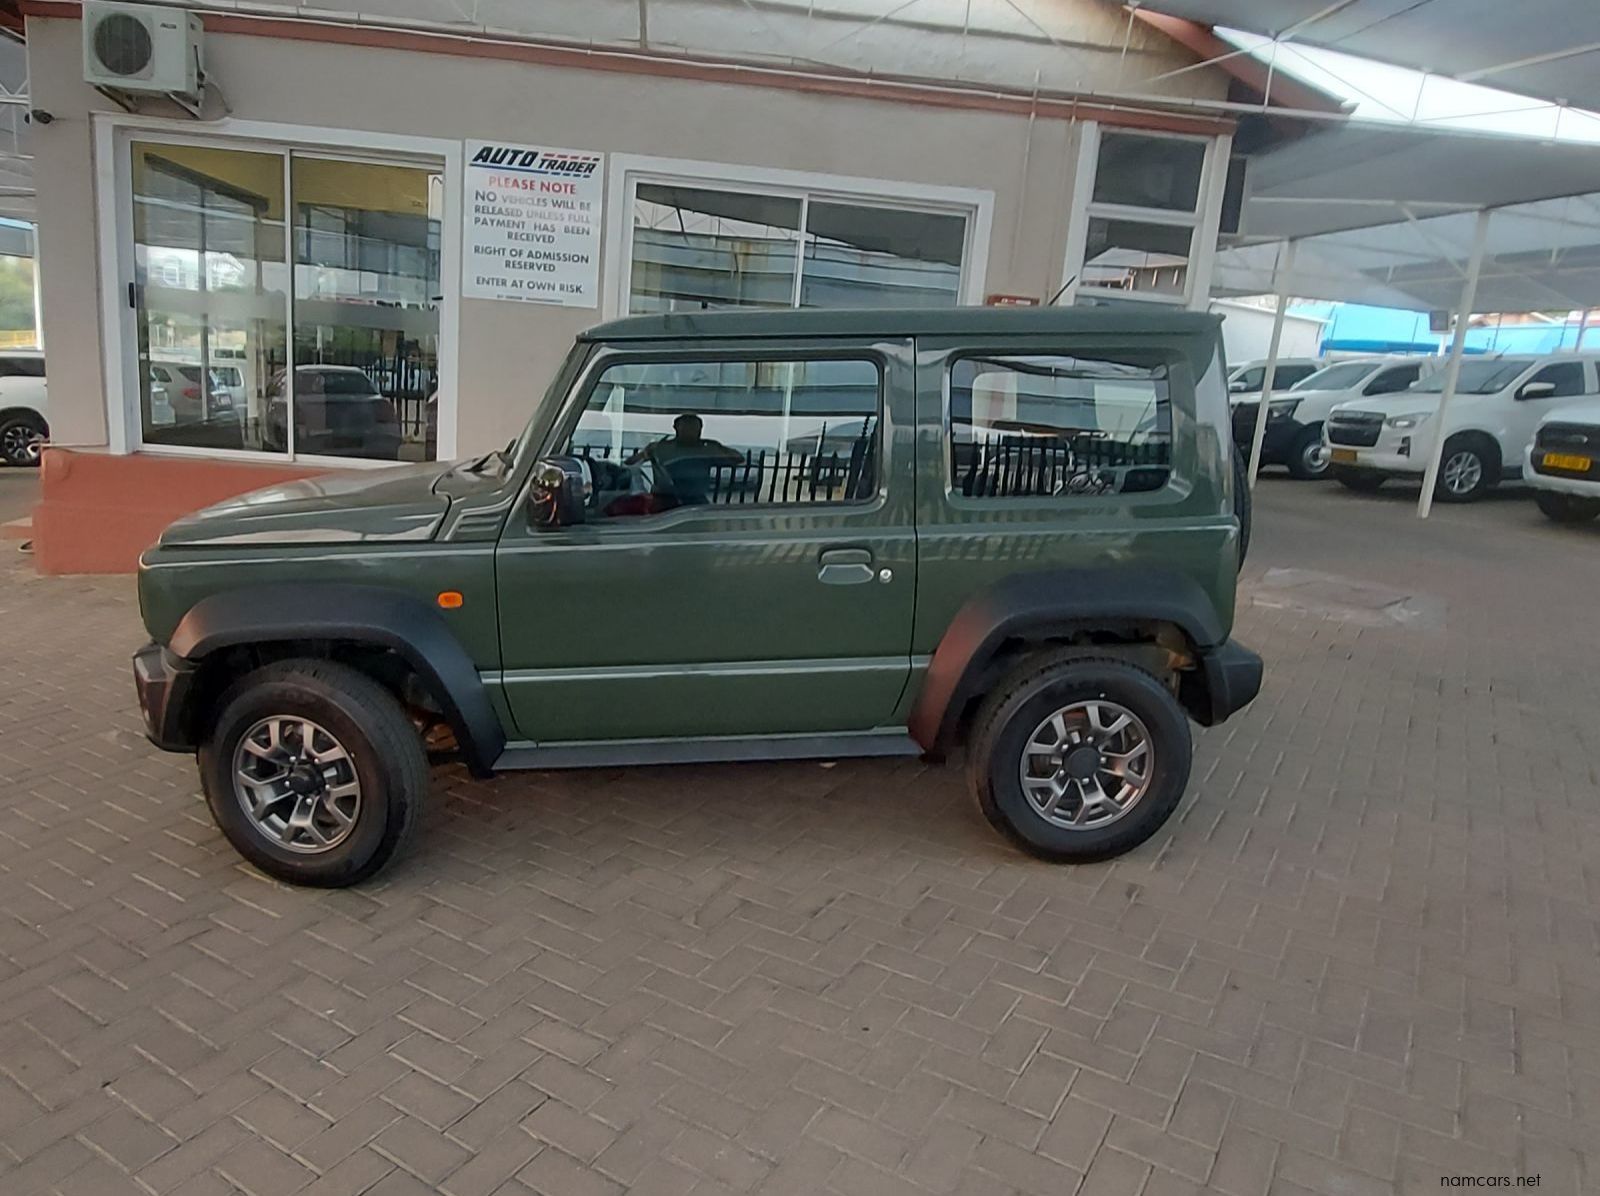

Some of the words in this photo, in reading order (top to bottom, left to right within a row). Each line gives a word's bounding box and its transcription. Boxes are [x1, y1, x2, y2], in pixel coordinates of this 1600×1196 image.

[472, 146, 539, 168] AUTO
[538, 158, 597, 174] TRADER
[488, 175, 536, 191] PLEASE
[540, 181, 577, 195] NOTE
[475, 190, 497, 202] NO
[501, 194, 548, 208] VEHICLES
[551, 199, 575, 210] WILL
[579, 201, 591, 211] BE
[474, 204, 523, 218] RELEASED
[526, 210, 564, 222] UNLESS
[568, 213, 590, 224] FULL
[474, 216, 526, 230] PAYMENT
[533, 221, 556, 233] HAS
[564, 225, 591, 236] BEEN
[507, 231, 555, 244] RECEIVED
[474, 245, 506, 257] RIGHT
[509, 248, 524, 258] OF
[526, 250, 589, 264] ADMISSION
[504, 259, 556, 272] RESERVED
[476, 276, 507, 287] ENTER
[511, 279, 524, 289] AT
[527, 280, 556, 292] OWN
